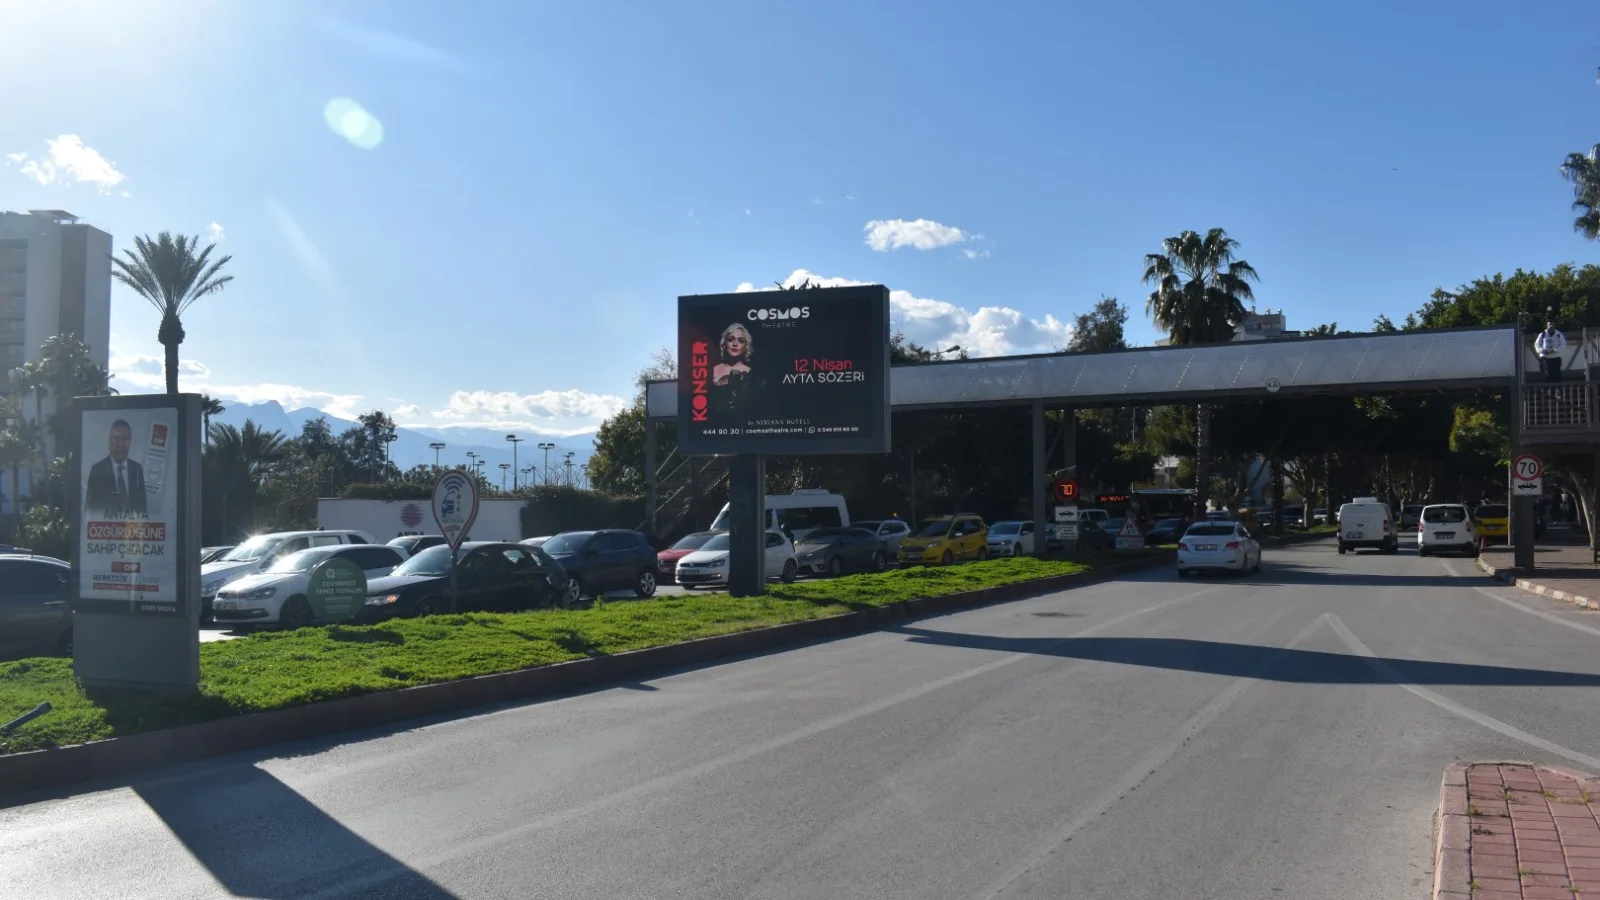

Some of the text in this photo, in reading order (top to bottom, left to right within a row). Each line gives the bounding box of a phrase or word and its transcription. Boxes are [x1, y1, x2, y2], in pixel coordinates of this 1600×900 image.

[747, 306, 810, 320] COSMOS
[762, 321, 796, 329] THEATRE
[794, 358, 853, 372] 12 Nisan
[692, 341, 708, 421] KONSER
[782, 373, 815, 384] AYTA
[745, 426, 803, 434] cosmostheatre.com
[1519, 461, 1537, 475] 70
[1061, 484, 1073, 495] 70
[103, 507, 149, 520] ANTALYA
[87, 540, 165, 559] SAHİP ÇIKACAK
